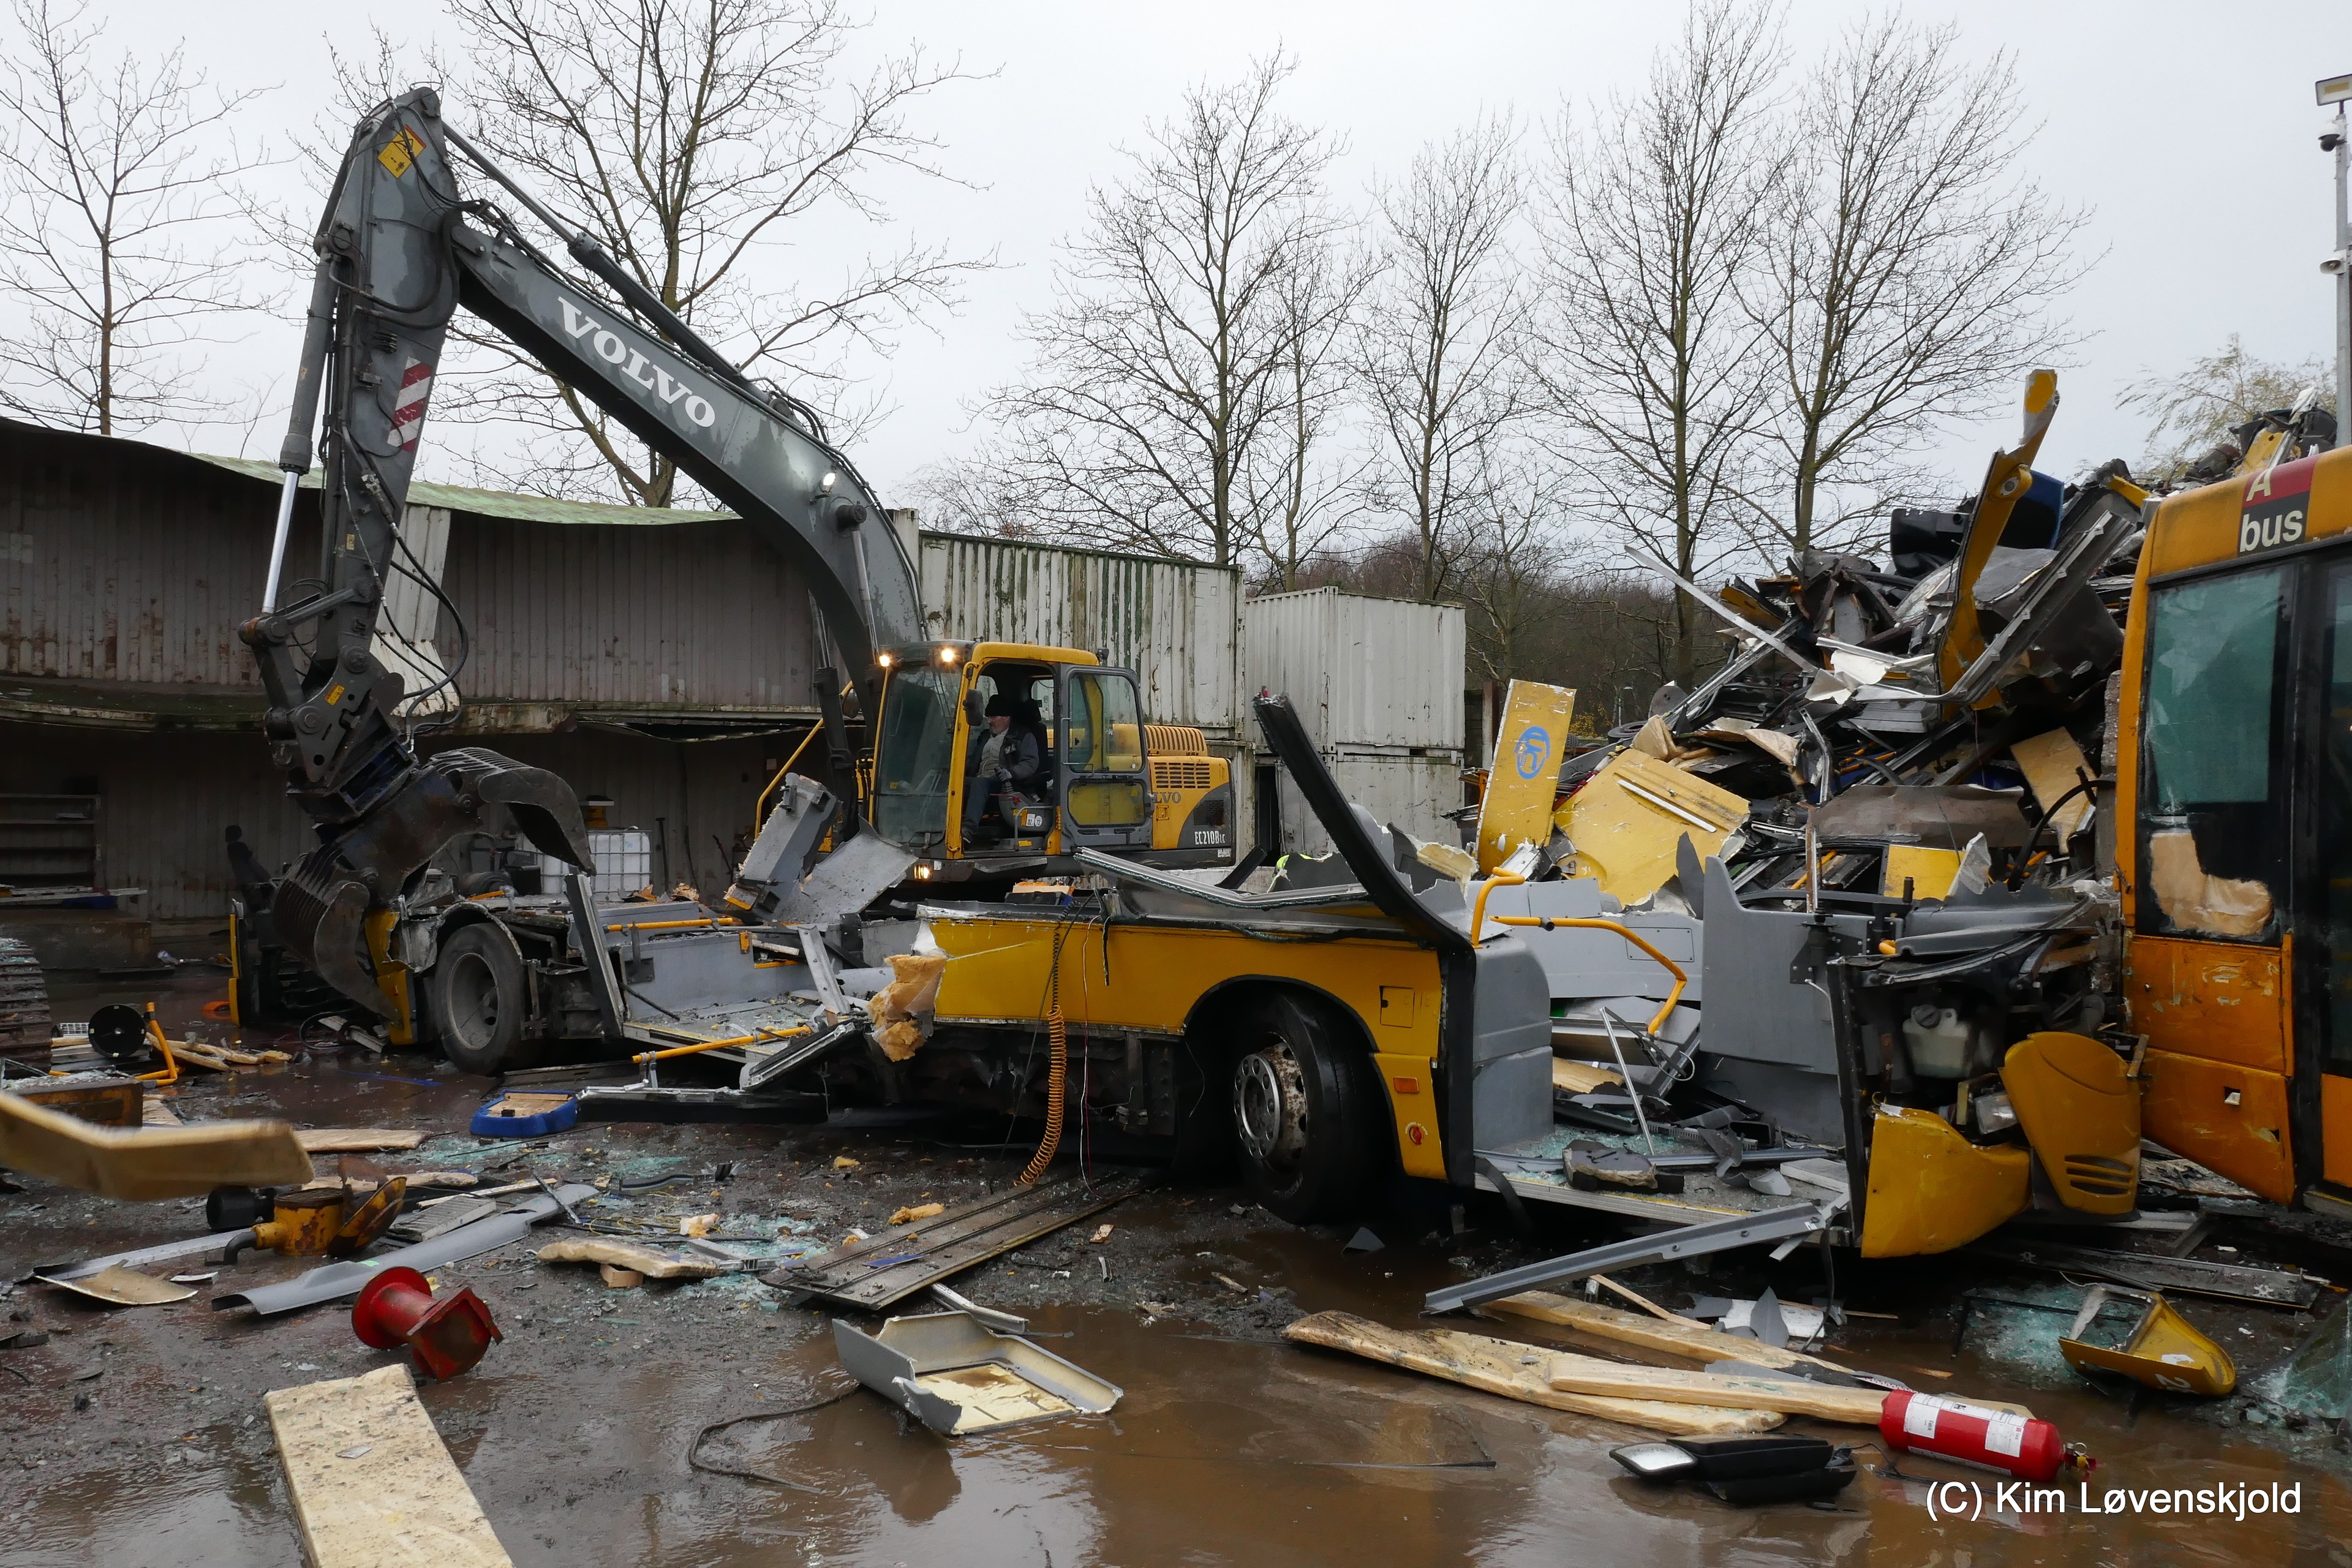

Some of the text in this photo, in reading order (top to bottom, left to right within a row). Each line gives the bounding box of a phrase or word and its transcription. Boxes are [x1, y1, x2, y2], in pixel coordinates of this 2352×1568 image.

[557, 296, 716, 428] VOLVO
[2245, 467, 2274, 502] A
[2239, 510, 2303, 552] bus
[1152, 791, 1182, 804] LVO
